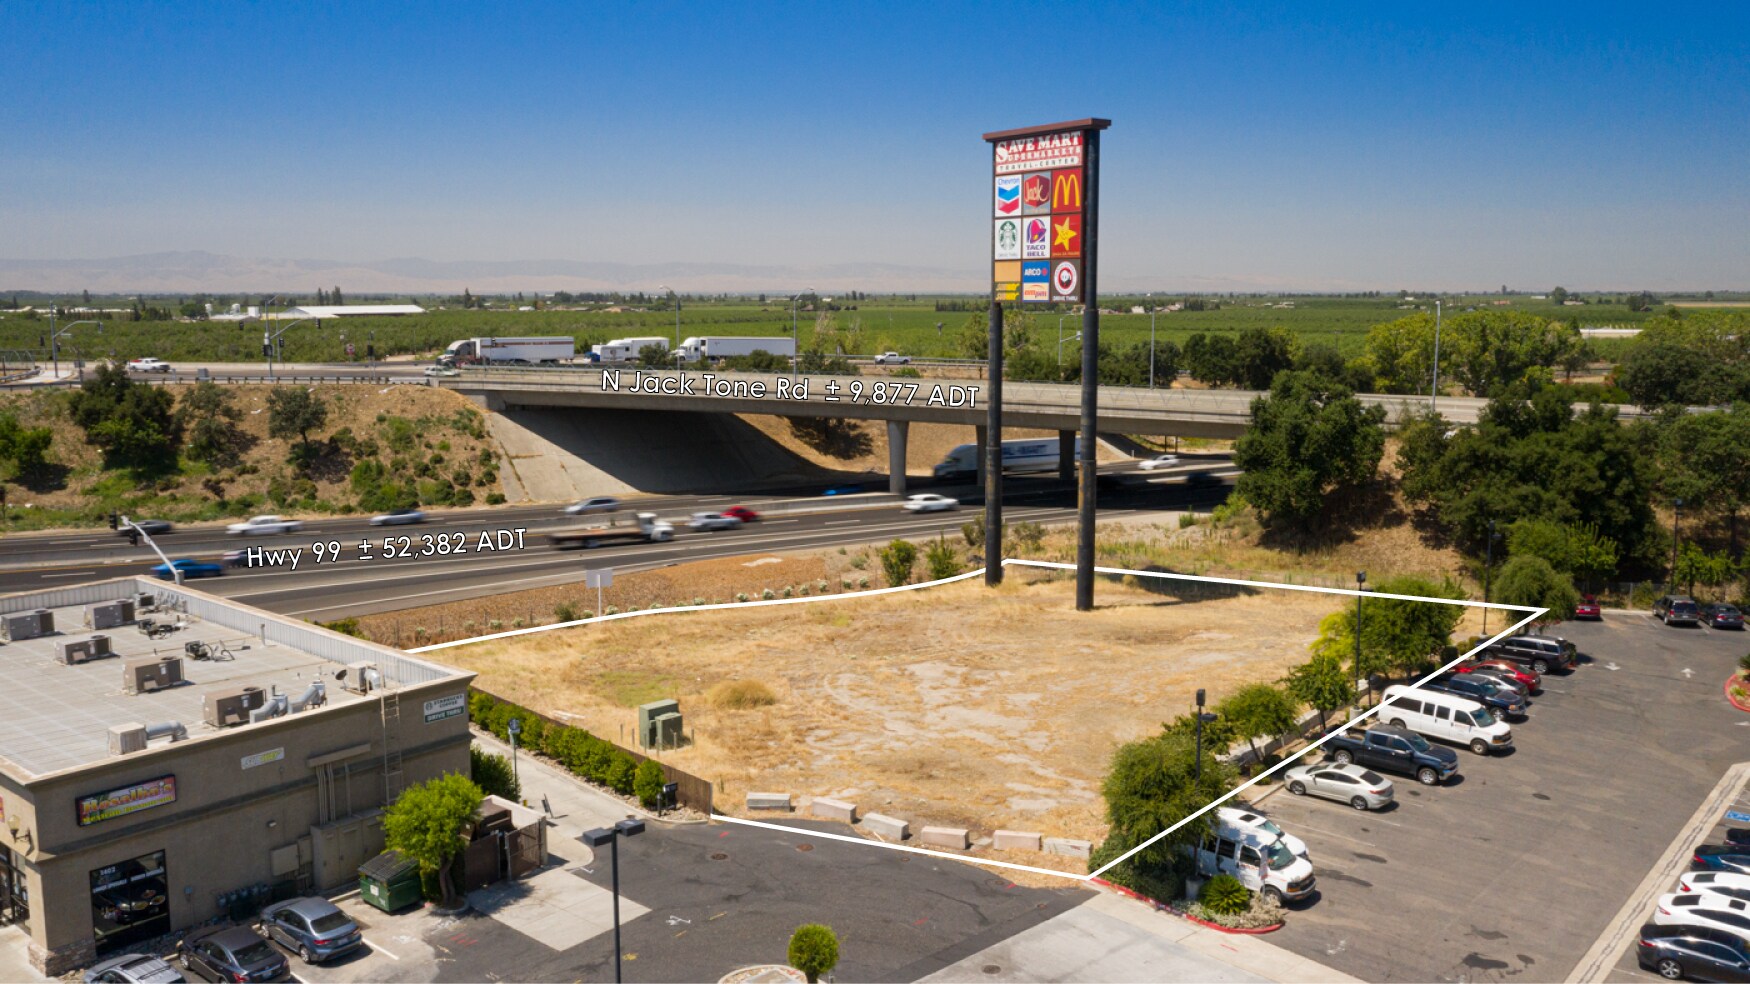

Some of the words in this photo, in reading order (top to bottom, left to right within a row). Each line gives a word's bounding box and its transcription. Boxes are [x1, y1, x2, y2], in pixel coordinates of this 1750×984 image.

[996, 137, 1035, 163] SAVE
[1037, 131, 1081, 150] MART
[1024, 268, 1042, 276] ARCO
